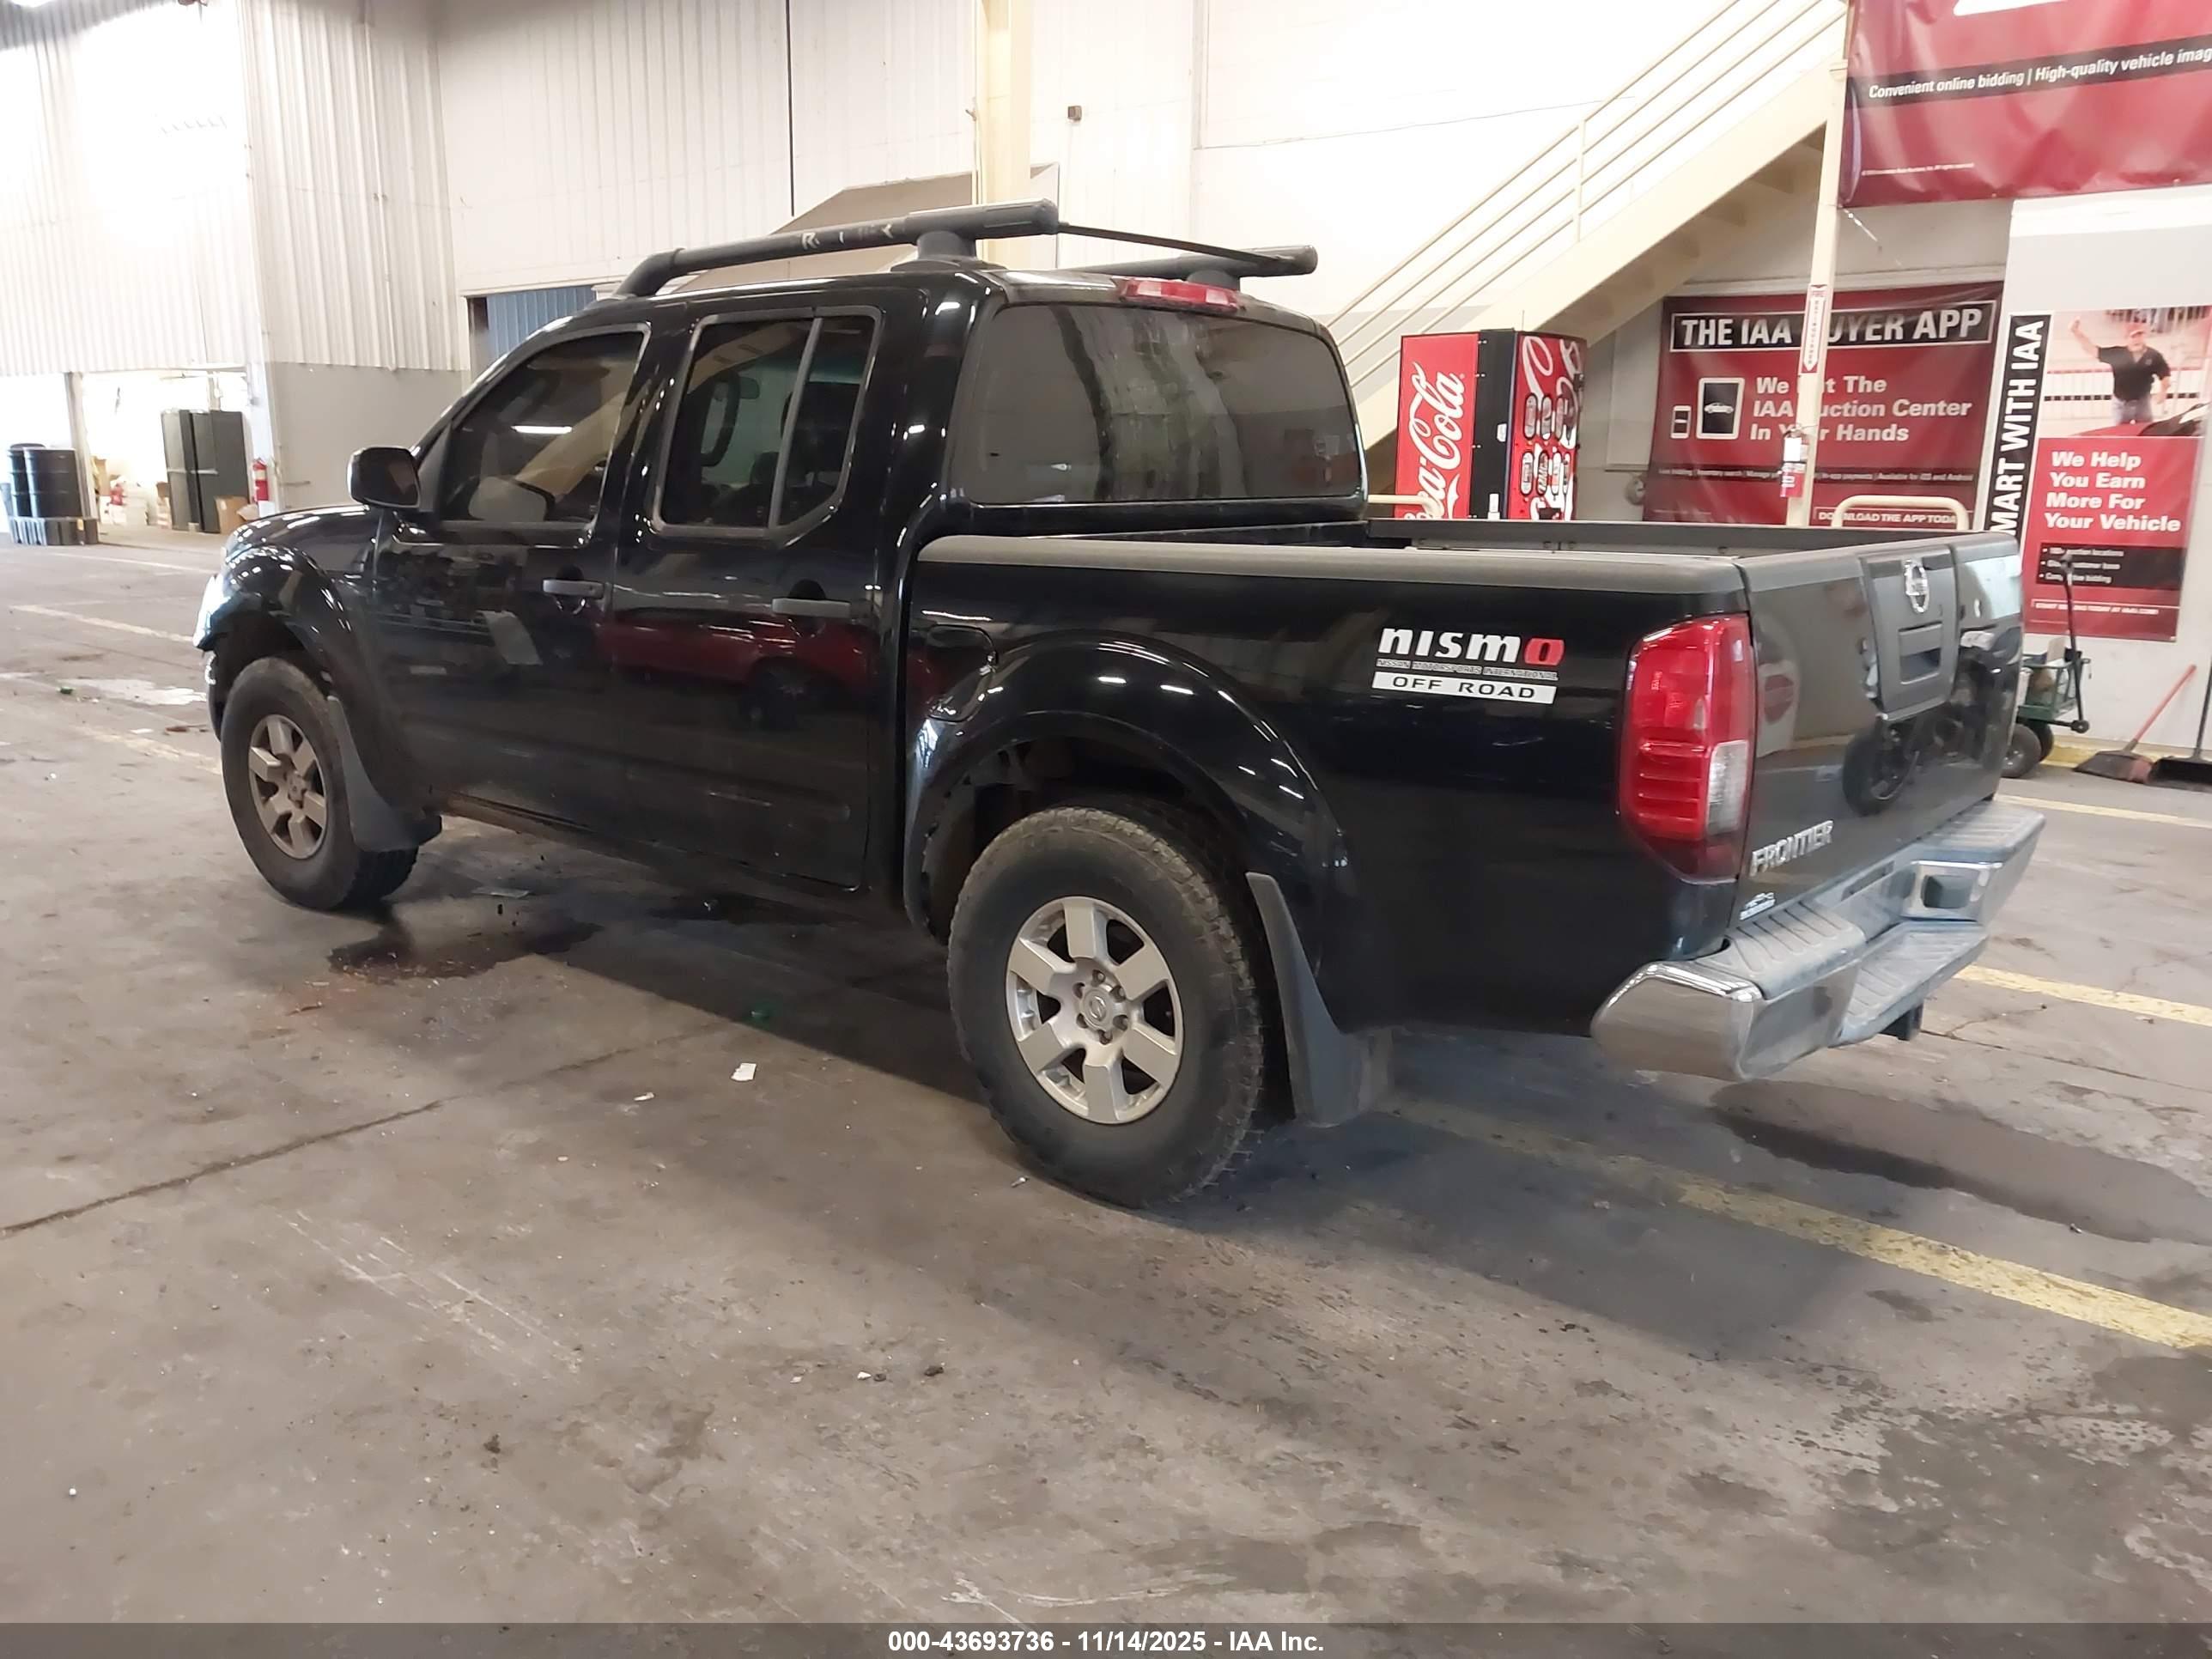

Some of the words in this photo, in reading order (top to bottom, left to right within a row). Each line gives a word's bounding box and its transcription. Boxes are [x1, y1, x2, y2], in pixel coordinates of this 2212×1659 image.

[1869, 80, 1935, 99] Convenient
[1936, 76, 1975, 92] online
[1978, 71, 2025, 88] bidding
[2035, 58, 2118, 83] High-quality
[2121, 51, 2174, 71] vehicle
[1680, 318, 1734, 346] THE
[1741, 318, 1792, 344] IAA
[1826, 313, 1905, 343] UYER
[1912, 307, 1983, 338] APP
[2011, 320, 2045, 370] IAA
[1756, 376, 1790, 394] We
[1843, 375, 1887, 393] The
[1753, 400, 1794, 417] IAA
[1820, 399, 1886, 417] uction
[1892, 398, 1972, 416] Center
[2001, 379, 2037, 452] WITH
[1749, 423, 1771, 441] In
[1836, 423, 1910, 441] Hands
[2051, 451, 2085, 467] We
[2090, 451, 2142, 471] Help
[2049, 471, 2089, 488] You
[2094, 472, 2146, 489] Earn
[1990, 457, 2026, 536] MART
[2045, 491, 2103, 508] More
[2108, 493, 2146, 510] For
[1818, 511, 1880, 522] DONLOAD
[1928, 514, 1957, 525] TODA
[2044, 512, 2094, 529] Your
[2100, 514, 2181, 532] Vehicle
[1377, 627, 1565, 667] nismo
[1393, 676, 1443, 690] OFF
[1458, 682, 1535, 699] ROAD
[1749, 819, 1834, 878] FRONTIER
